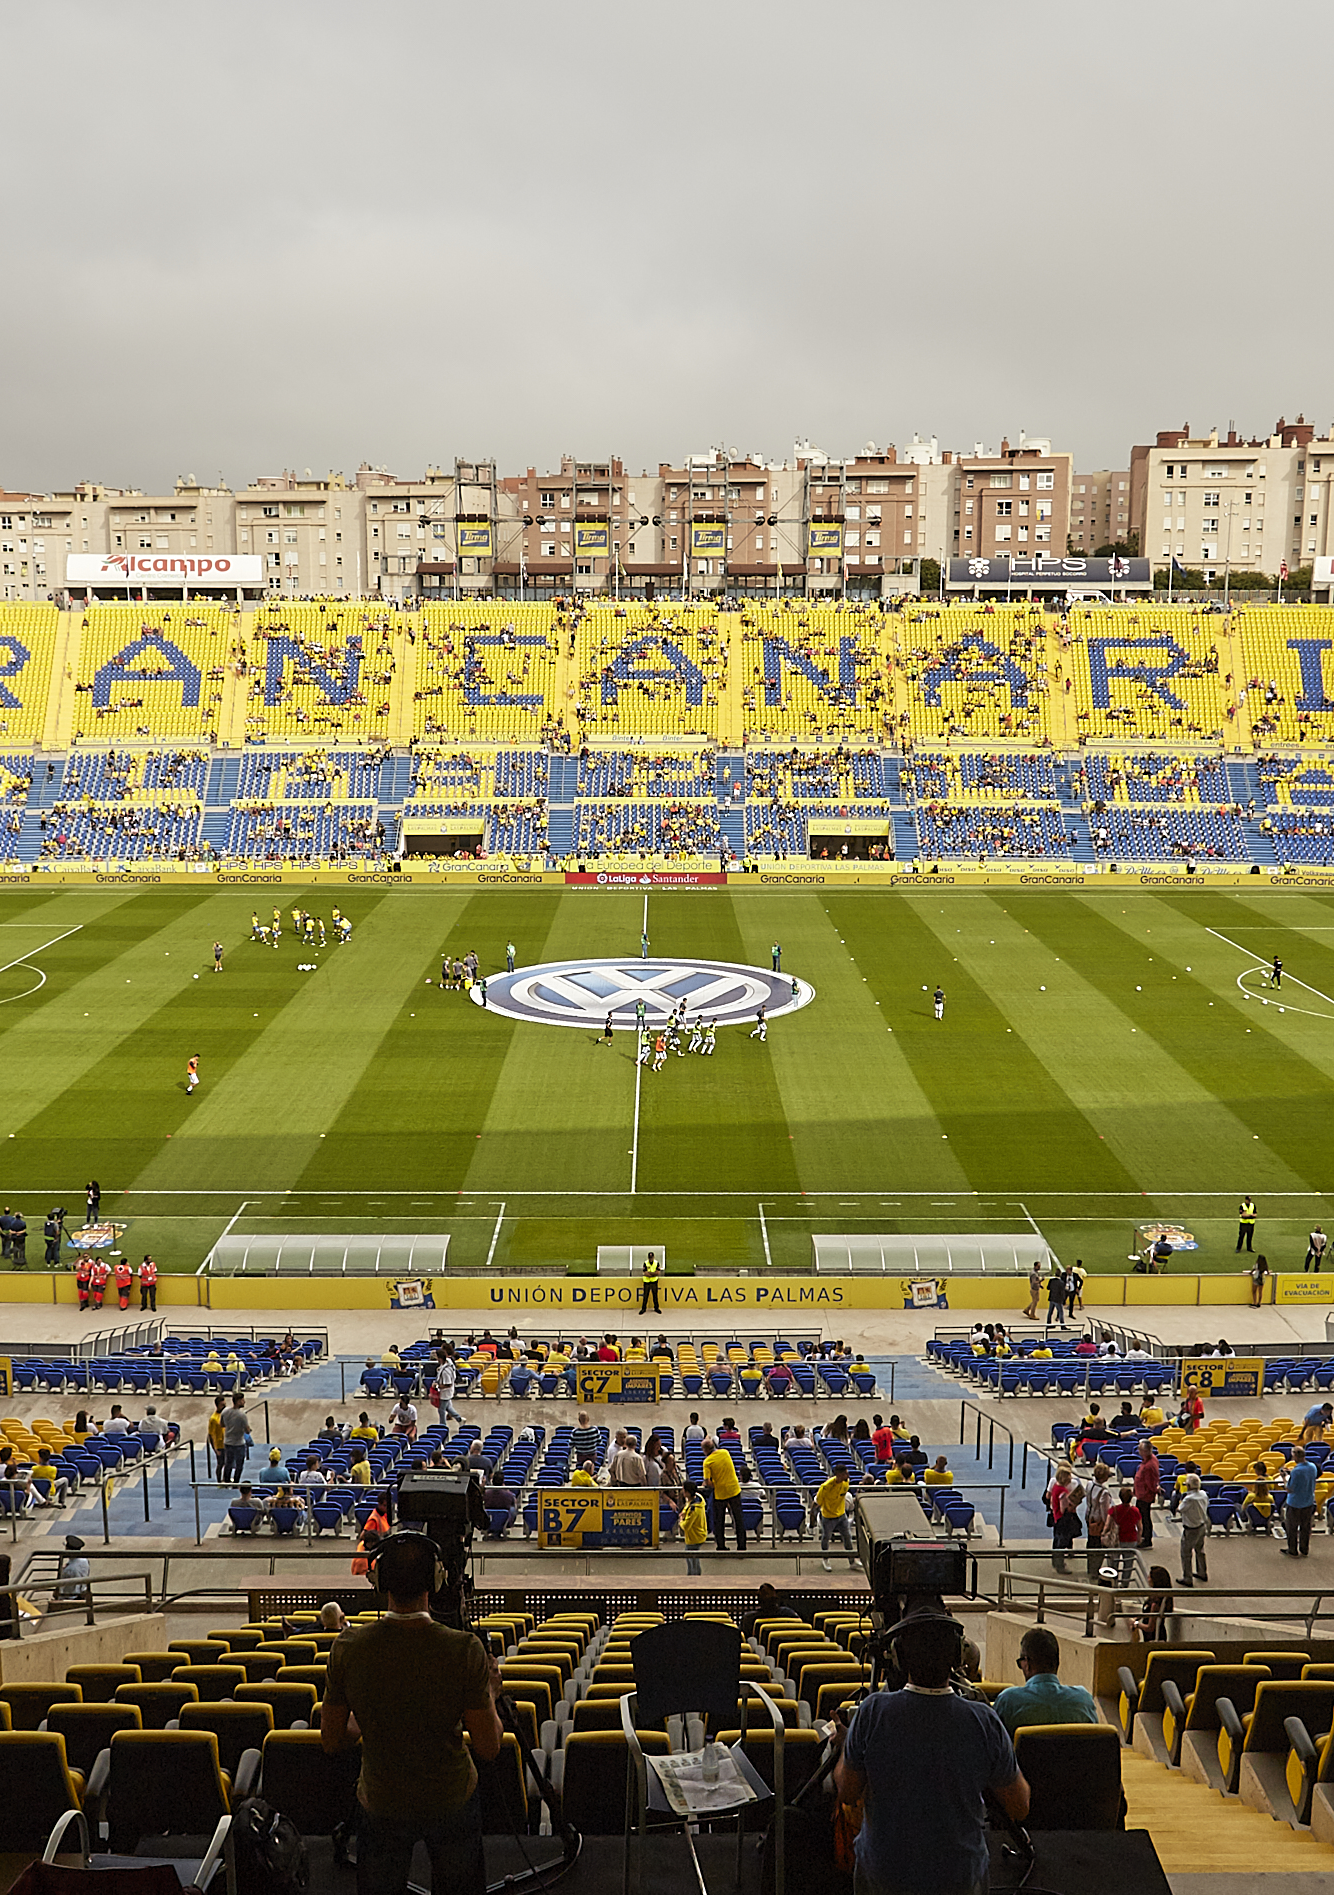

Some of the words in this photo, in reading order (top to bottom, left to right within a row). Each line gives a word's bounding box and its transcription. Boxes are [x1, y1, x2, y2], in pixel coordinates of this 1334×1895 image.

[464, 531, 488, 545] Tirma
[580, 530, 607, 545] Tirma
[696, 531, 723, 546] Tirma
[810, 531, 837, 546] Tirma
[101, 555, 231, 576] Alcampo
[1010, 557, 1087, 571] HPS
[219, 861, 249, 871] HPS
[254, 861, 283, 871] HPS
[291, 861, 321, 871] HPS
[328, 861, 358, 871] HPS
[442, 861, 509, 872] GranCanaria
[597, 860, 639, 873] Europea
[643, 860, 665, 871] del
[667, 860, 713, 873] Deporte
[788, 862, 833, 871] DEPORTIVA
[835, 862, 850, 871] LAS
[852, 862, 885, 871] PALMAS
[96, 874, 161, 884] GranCanaria
[217, 874, 282, 884] GranCanaria
[347, 874, 412, 884] GranCanaria
[477, 874, 542, 884] GranCanaria
[609, 874, 637, 885] LaLiga
[652, 874, 700, 884] Santander
[760, 874, 825, 885] GranCanaria
[890, 874, 955, 885] GranCanaria
[1020, 875, 1085, 885] GranCanaria
[1140, 875, 1205, 885] GranCanaria
[490, 1283, 563, 1304] UNIÓN
[571, 1286, 699, 1304] DEPORIVA
[706, 1286, 746, 1304] LAS
[756, 1286, 845, 1304] PALMAS
[1284, 1288, 1330, 1296] EVACUACIÓN
[1184, 1370, 1213, 1388] C8
[580, 1376, 610, 1394] C7
[544, 1498, 600, 1508] SECTOR
[543, 1508, 587, 1532] B7
[613, 1517, 643, 1526] PARES
